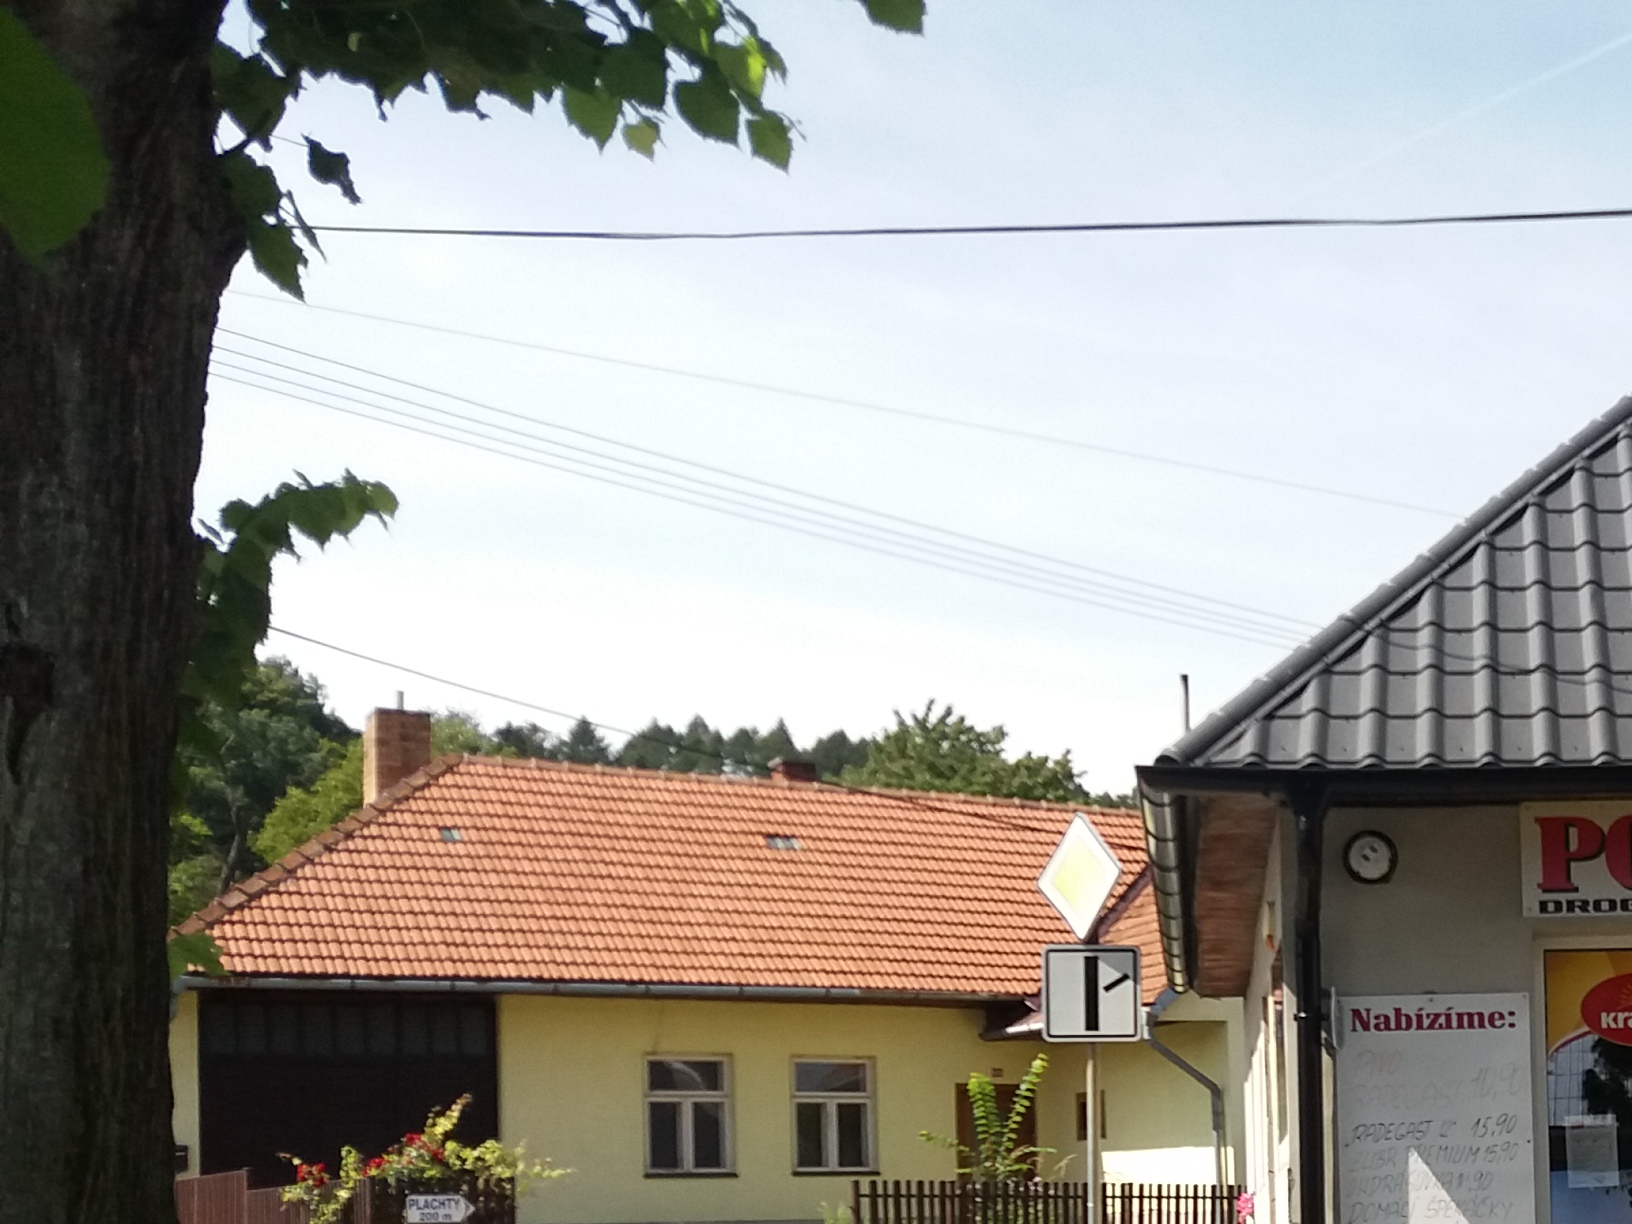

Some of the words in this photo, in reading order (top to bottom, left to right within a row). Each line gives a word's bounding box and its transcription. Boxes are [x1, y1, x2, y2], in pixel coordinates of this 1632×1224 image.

[1350, 1007, 1517, 1033] Nabízíme:
[1351, 1119, 1434, 1143] RADEGAST
[408, 1198, 460, 1210] PLACHTY
[419, 1212, 439, 1221] 200
